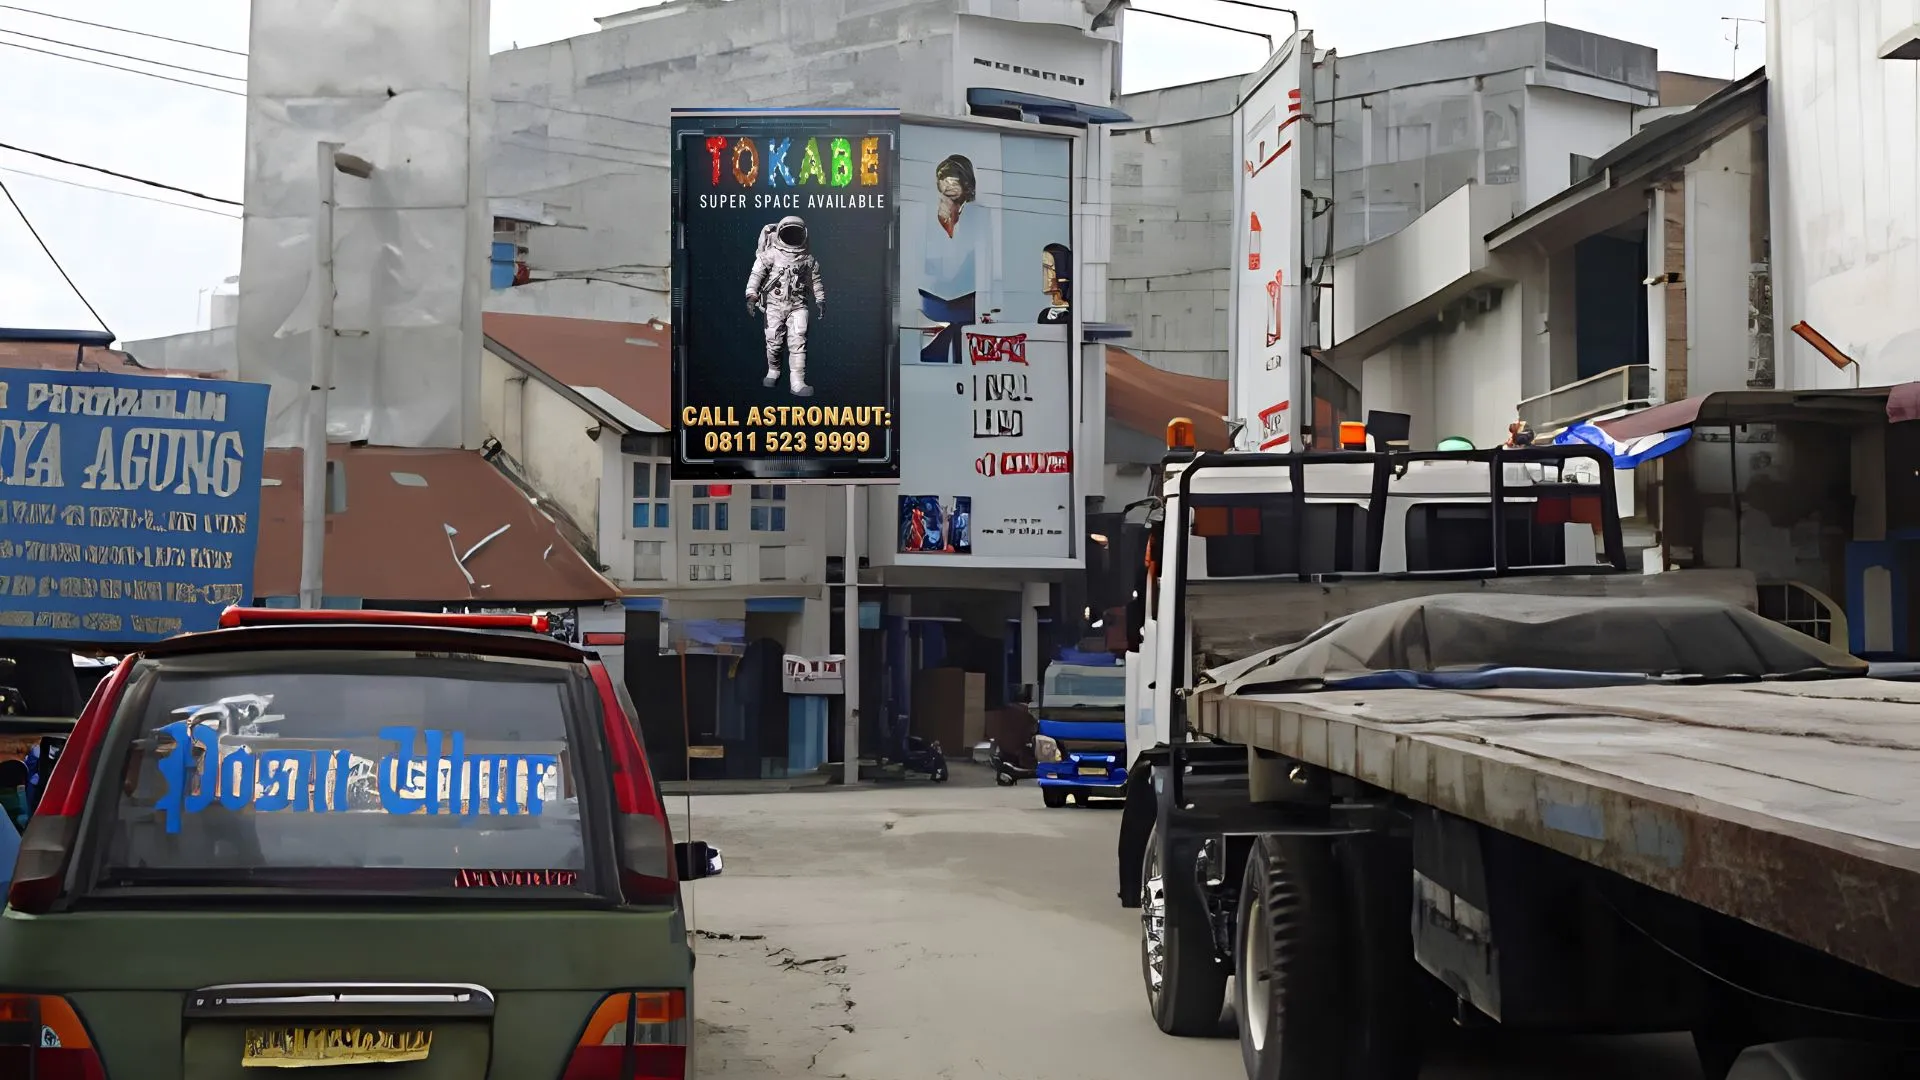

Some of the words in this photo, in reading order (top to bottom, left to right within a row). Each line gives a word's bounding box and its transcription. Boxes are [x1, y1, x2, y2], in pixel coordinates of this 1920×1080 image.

[705, 136, 879, 188] TOKABE
[699, 194, 747, 209] SUPER
[754, 194, 800, 209] SPACE
[807, 194, 885, 209] AVAILABLE
[682, 406, 739, 427] CALL
[746, 406, 892, 427] ASTRONAUT:
[704, 431, 757, 452] 0811
[765, 431, 807, 452] 523
[814, 431, 870, 452] 9999
[81, 425, 244, 498] AGUNG
